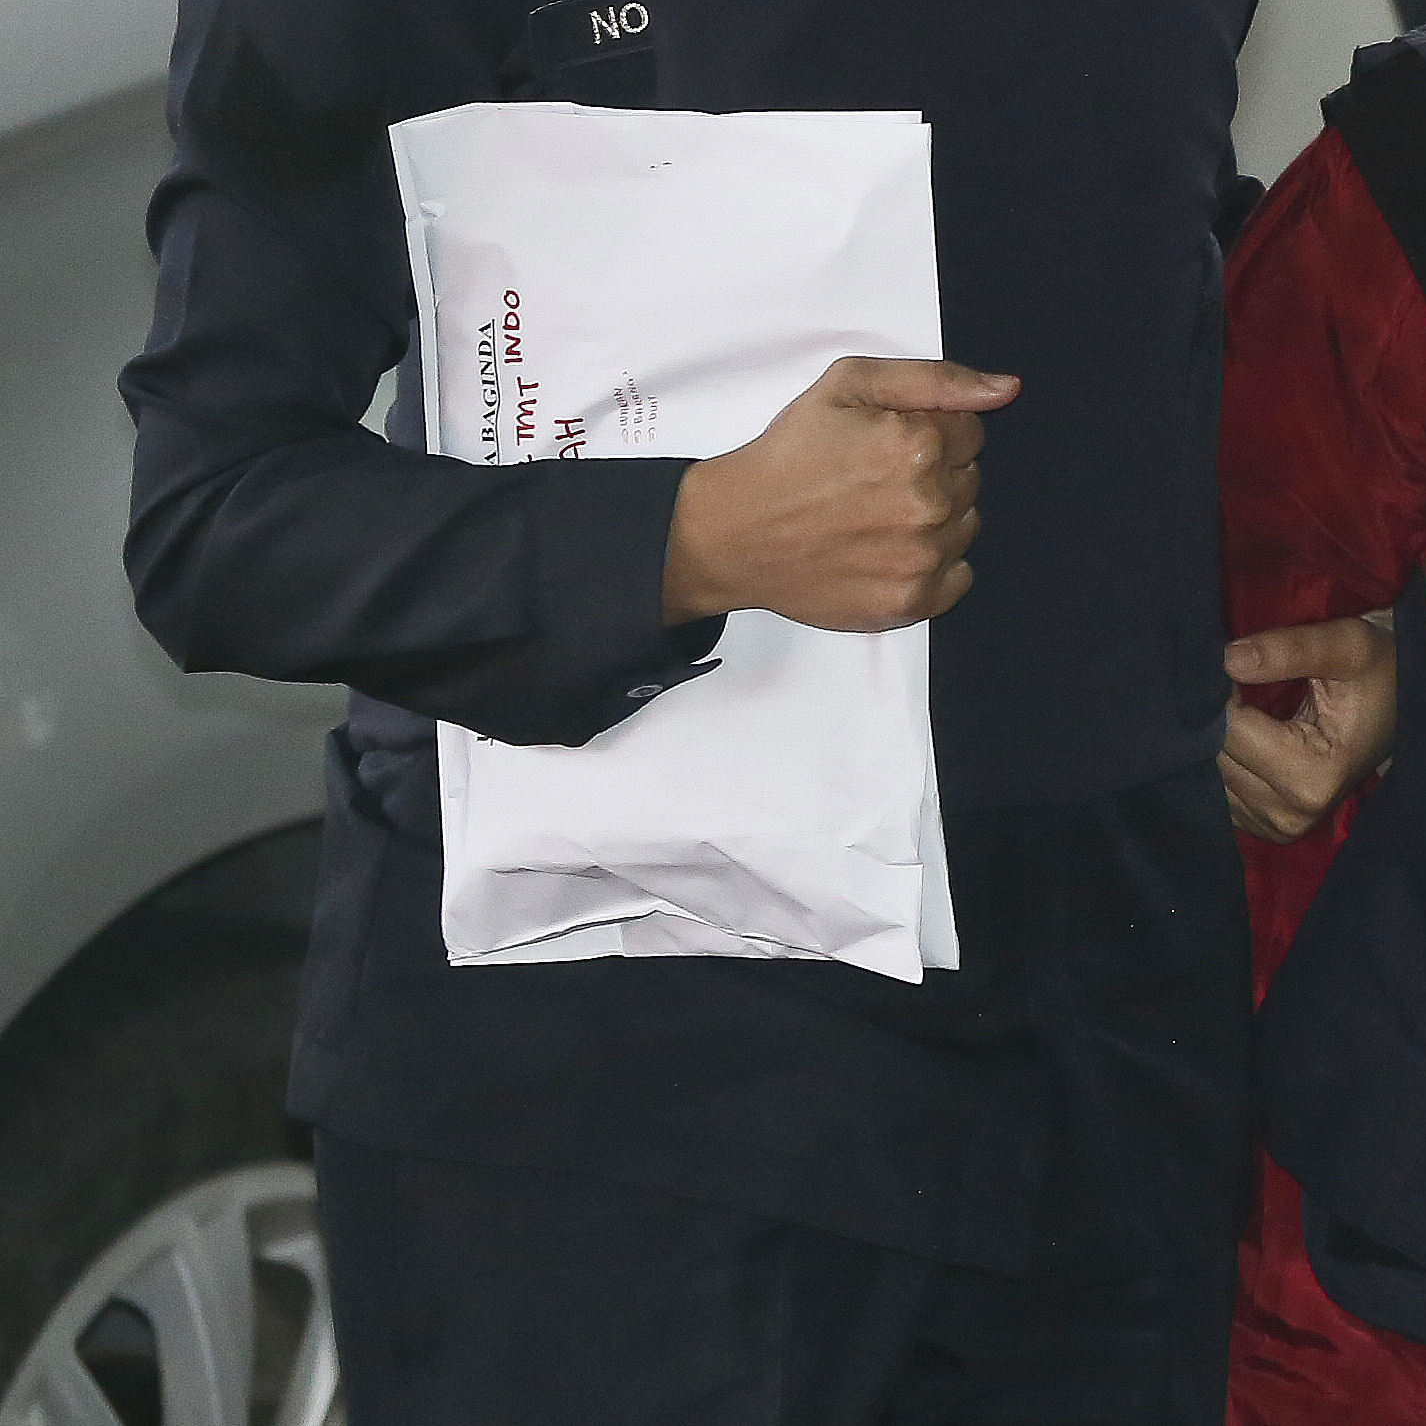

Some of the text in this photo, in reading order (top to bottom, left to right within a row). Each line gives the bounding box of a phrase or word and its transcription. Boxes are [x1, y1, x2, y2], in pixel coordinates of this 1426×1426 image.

[589, 2, 650, 45] NO
[503, 290, 523, 364] INDO
[478, 322, 497, 442] BAGINDA
[516, 376, 539, 446] TMT
